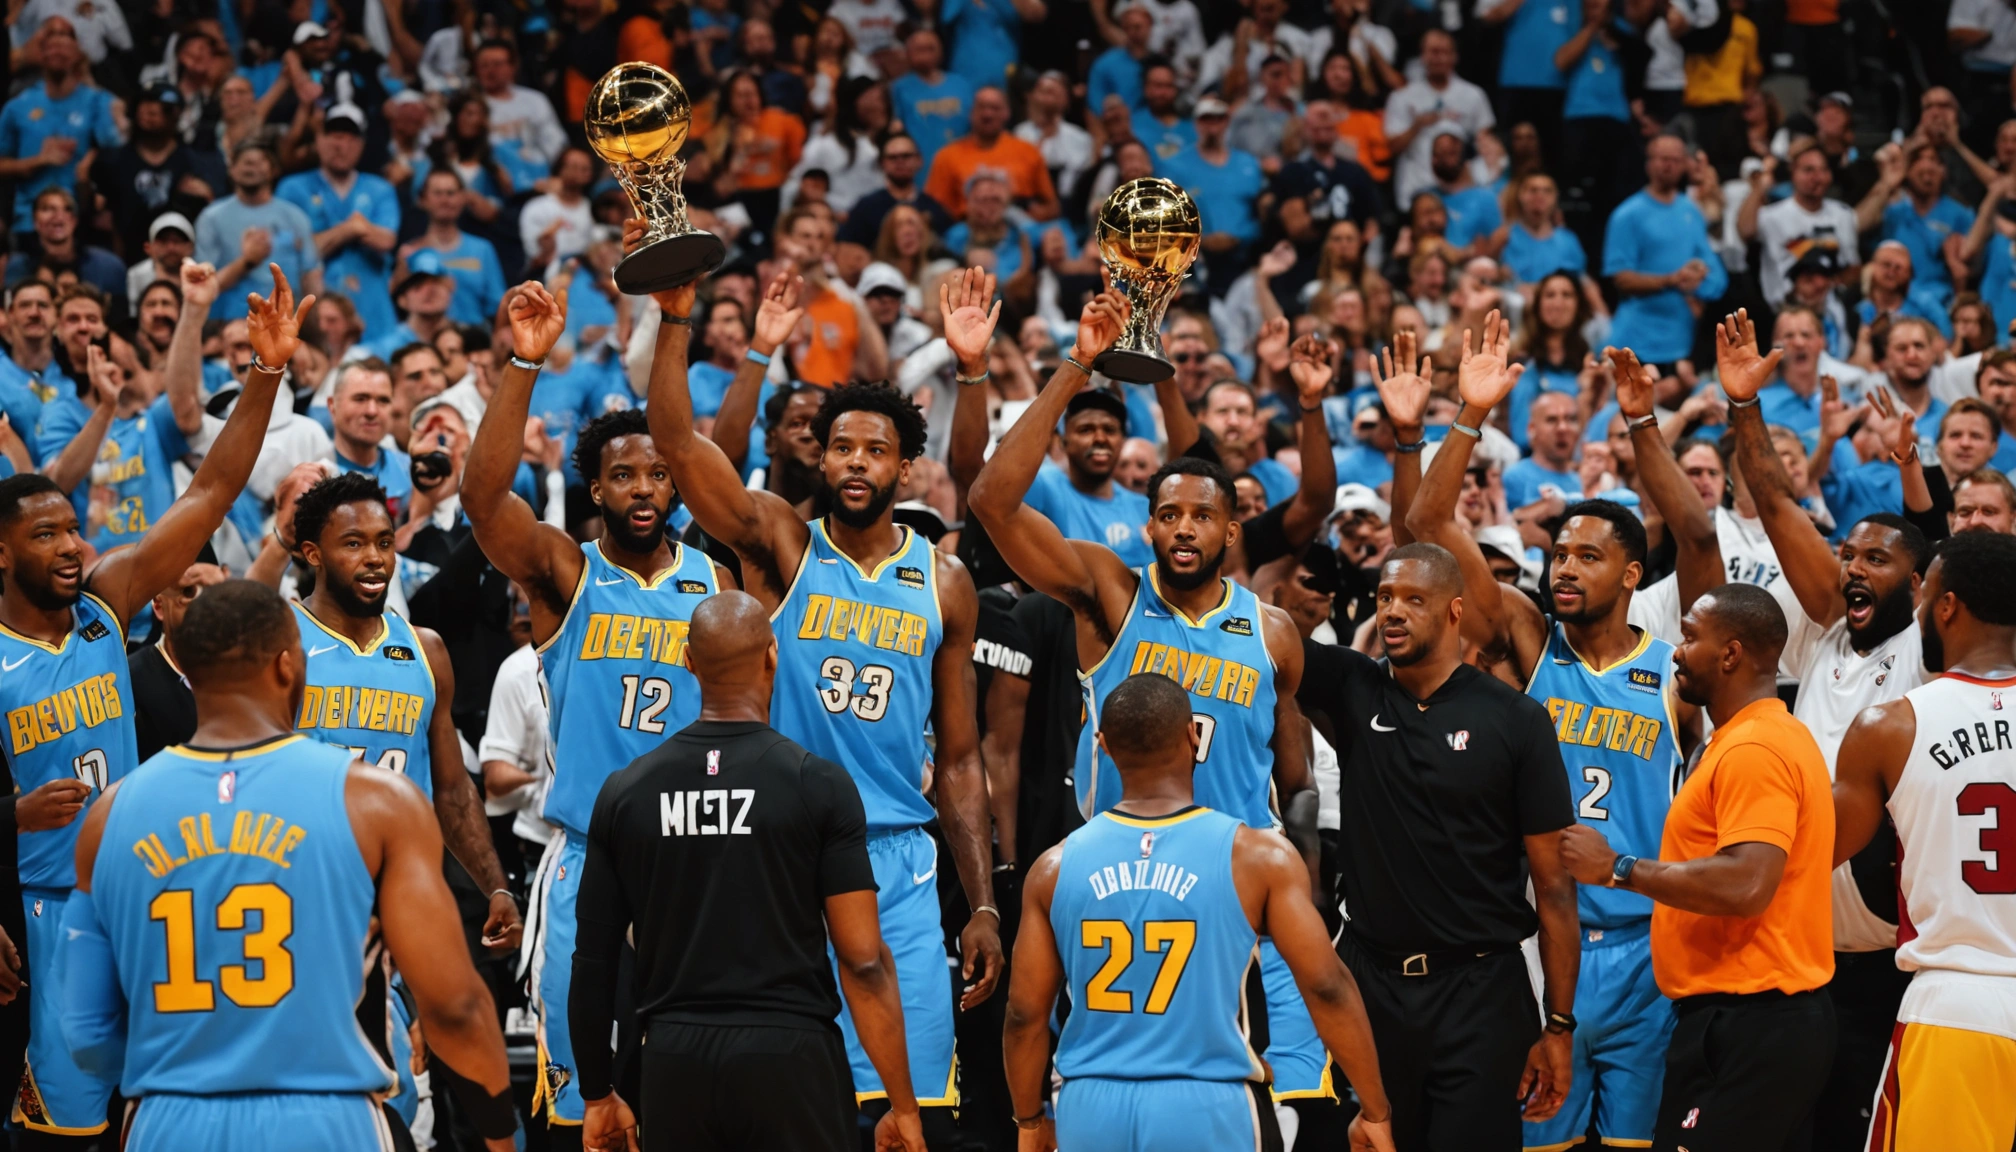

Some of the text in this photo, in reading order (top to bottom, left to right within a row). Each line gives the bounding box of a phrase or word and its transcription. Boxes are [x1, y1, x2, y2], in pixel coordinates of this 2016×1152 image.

[619, 675, 672, 735] 12
[1579, 766, 1612, 821] 2
[149, 882, 295, 1014] 13
[1081, 919, 1197, 1015] 27
